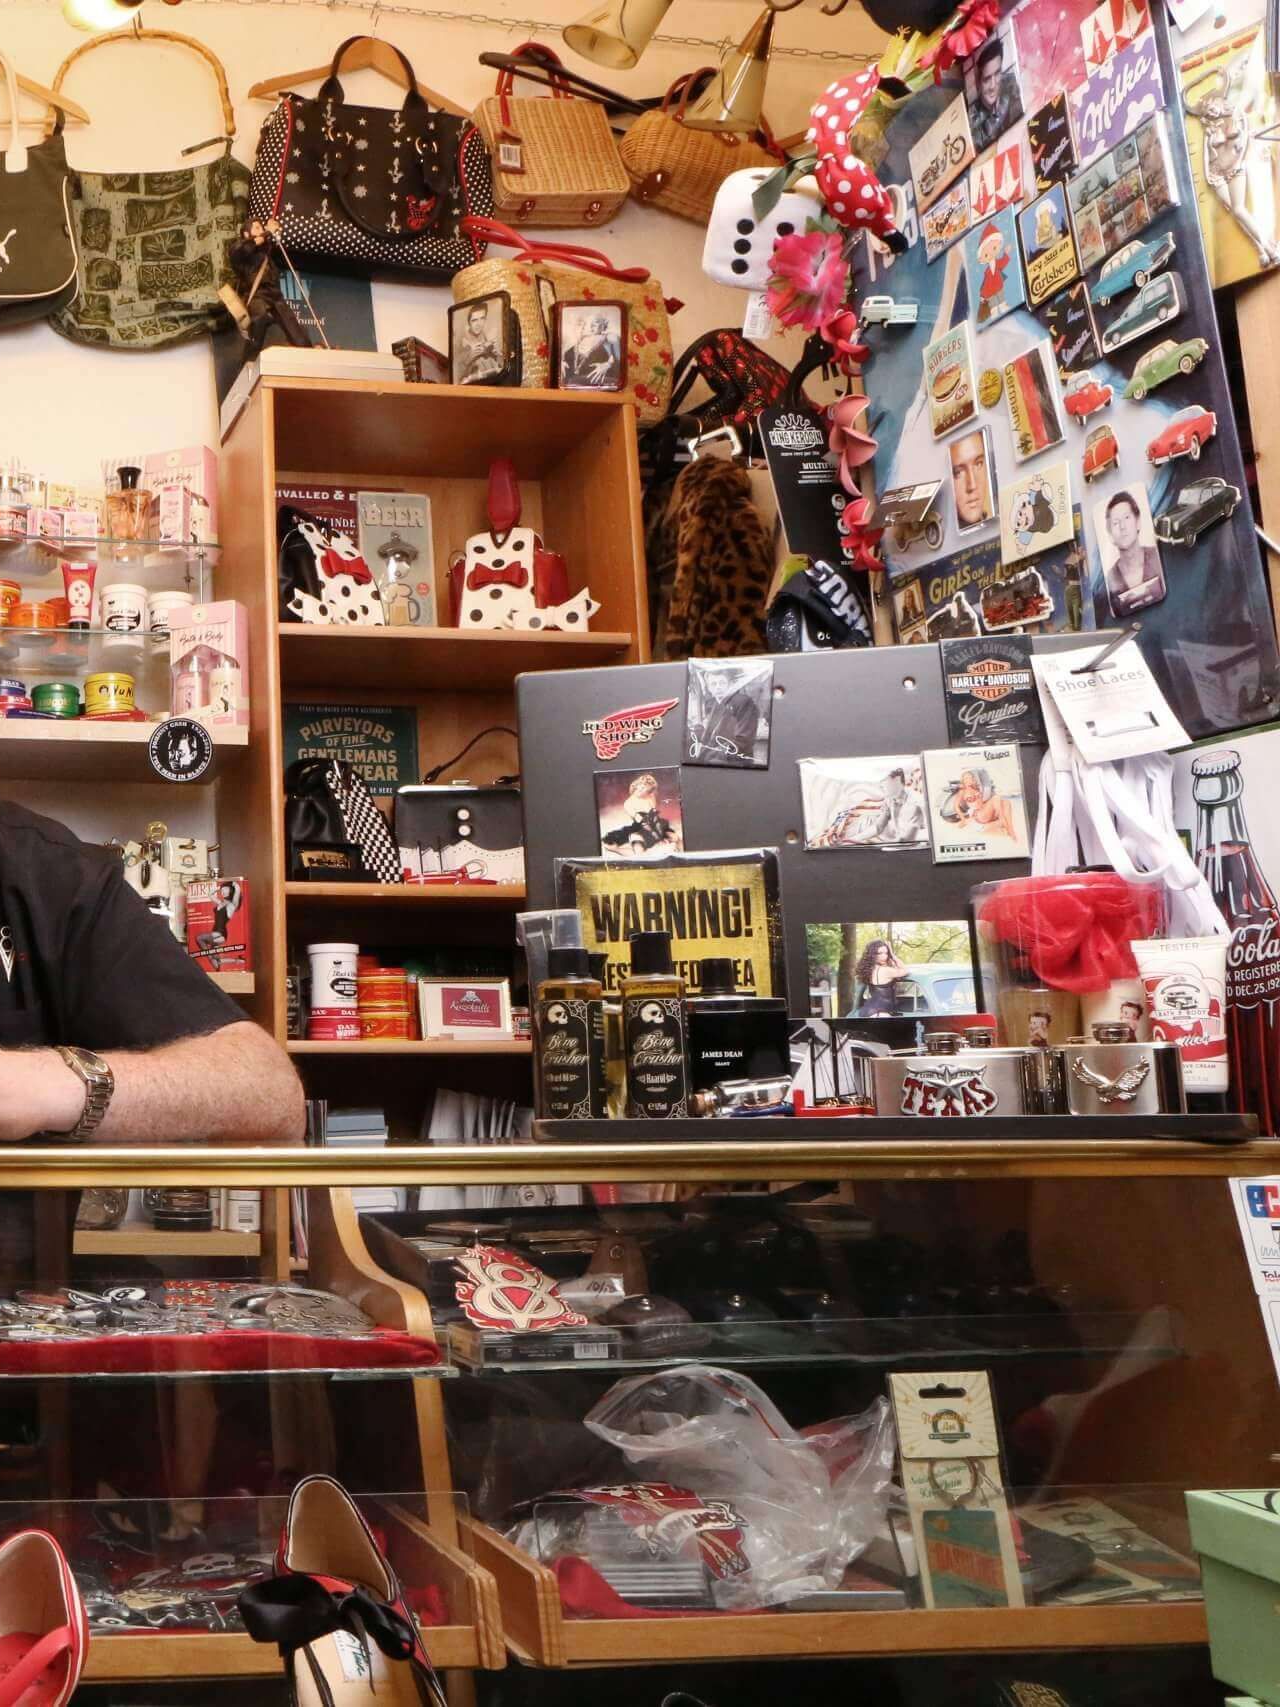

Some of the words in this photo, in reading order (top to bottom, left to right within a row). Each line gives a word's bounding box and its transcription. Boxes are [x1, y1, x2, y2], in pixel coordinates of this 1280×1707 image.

[1082, 54, 1152, 142] Milka
[1030, 257, 1076, 297] Carlsberg
[928, 338, 962, 373] BURGERS
[1005, 363, 1022, 432] Germany
[333, 489, 346, 501] &
[364, 504, 424, 528] BEER
[971, 566, 985, 581] ON
[976, 573, 996, 589] THE
[928, 564, 971, 604] GIRLS
[972, 662, 1005, 673] MOTOR
[951, 672, 1030, 688] HARLEY-DAVIDSON
[1055, 678, 1097, 693] Shoe
[1099, 669, 1146, 686] Laces
[584, 721, 614, 731] RED
[620, 717, 662, 729] WING
[958, 700, 1029, 738] Genuine
[299, 717, 395, 744] PURVEYORS
[599, 730, 649, 743] SHOES
[325, 736, 340, 747] OF
[341, 734, 366, 746] FINE
[297, 748, 398, 764] GENTLEMANS
[160, 767, 177, 779] MAN
[590, 887, 753, 943] WARNING!
[1159, 942, 1200, 953] TESTER
[1226, 917, 1280, 967] Cola
[546, 1031, 579, 1049] Bone
[641, 1032, 675, 1050] Bone
[542, 1050, 589, 1066] Crusher
[632, 1050, 685, 1067] Crusher
[702, 1051, 723, 1059] JAMES
[723, 1050, 743, 1058] DEAN
[903, 1076, 996, 1116] TEXAS
